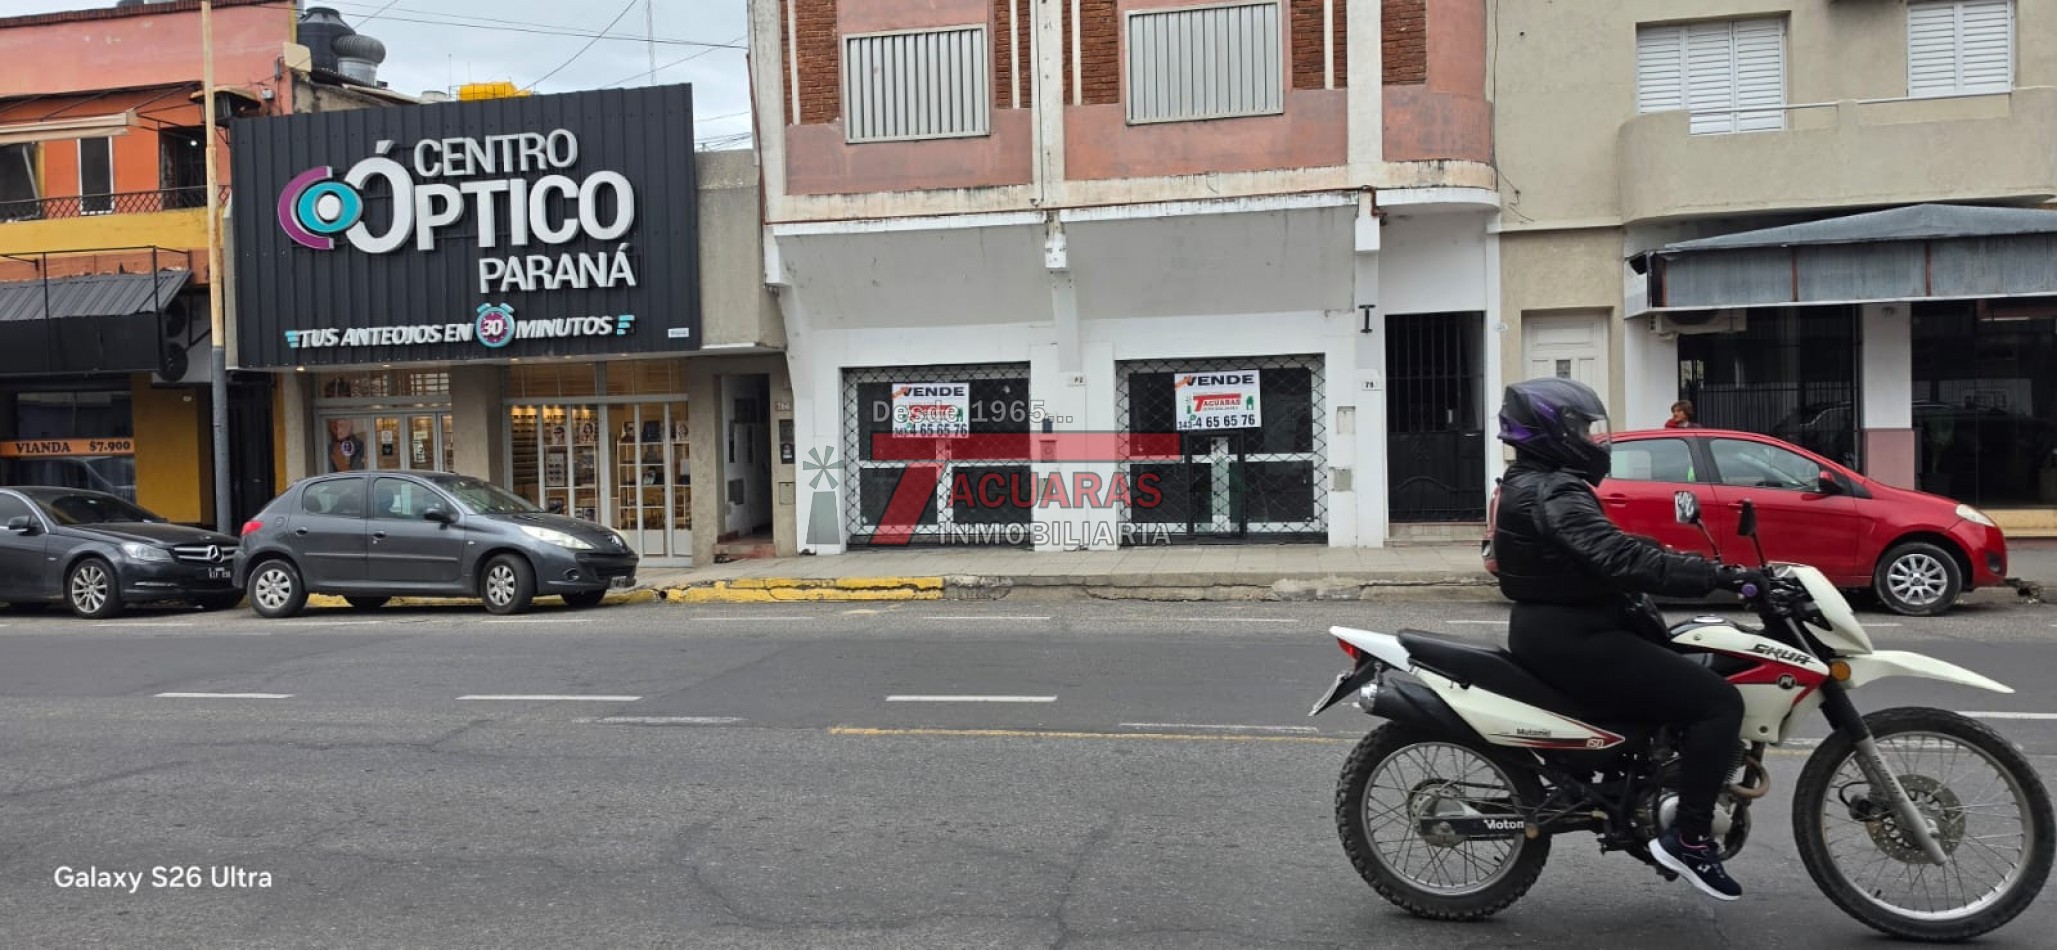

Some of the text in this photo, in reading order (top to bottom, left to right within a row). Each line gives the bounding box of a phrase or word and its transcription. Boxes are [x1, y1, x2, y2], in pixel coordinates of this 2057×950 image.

[414, 129, 578, 177] CENTRO
[344, 140, 635, 254] ÓPTICO
[479, 243, 637, 293] PARANÁ
[301, 316, 613, 348] TUS ANTEOJOS EN 30 MINUTOS
[1187, 374, 1255, 386] VENDE
[903, 386, 966, 397] VENDE
[1205, 416, 1220, 428] 65
[1223, 415, 1238, 427] 65
[1241, 414, 1256, 425] 76
[920, 423, 933, 437] 65
[936, 423, 950, 437] 65
[953, 423, 968, 437] 76
[16, 441, 72, 453] VIANDA
